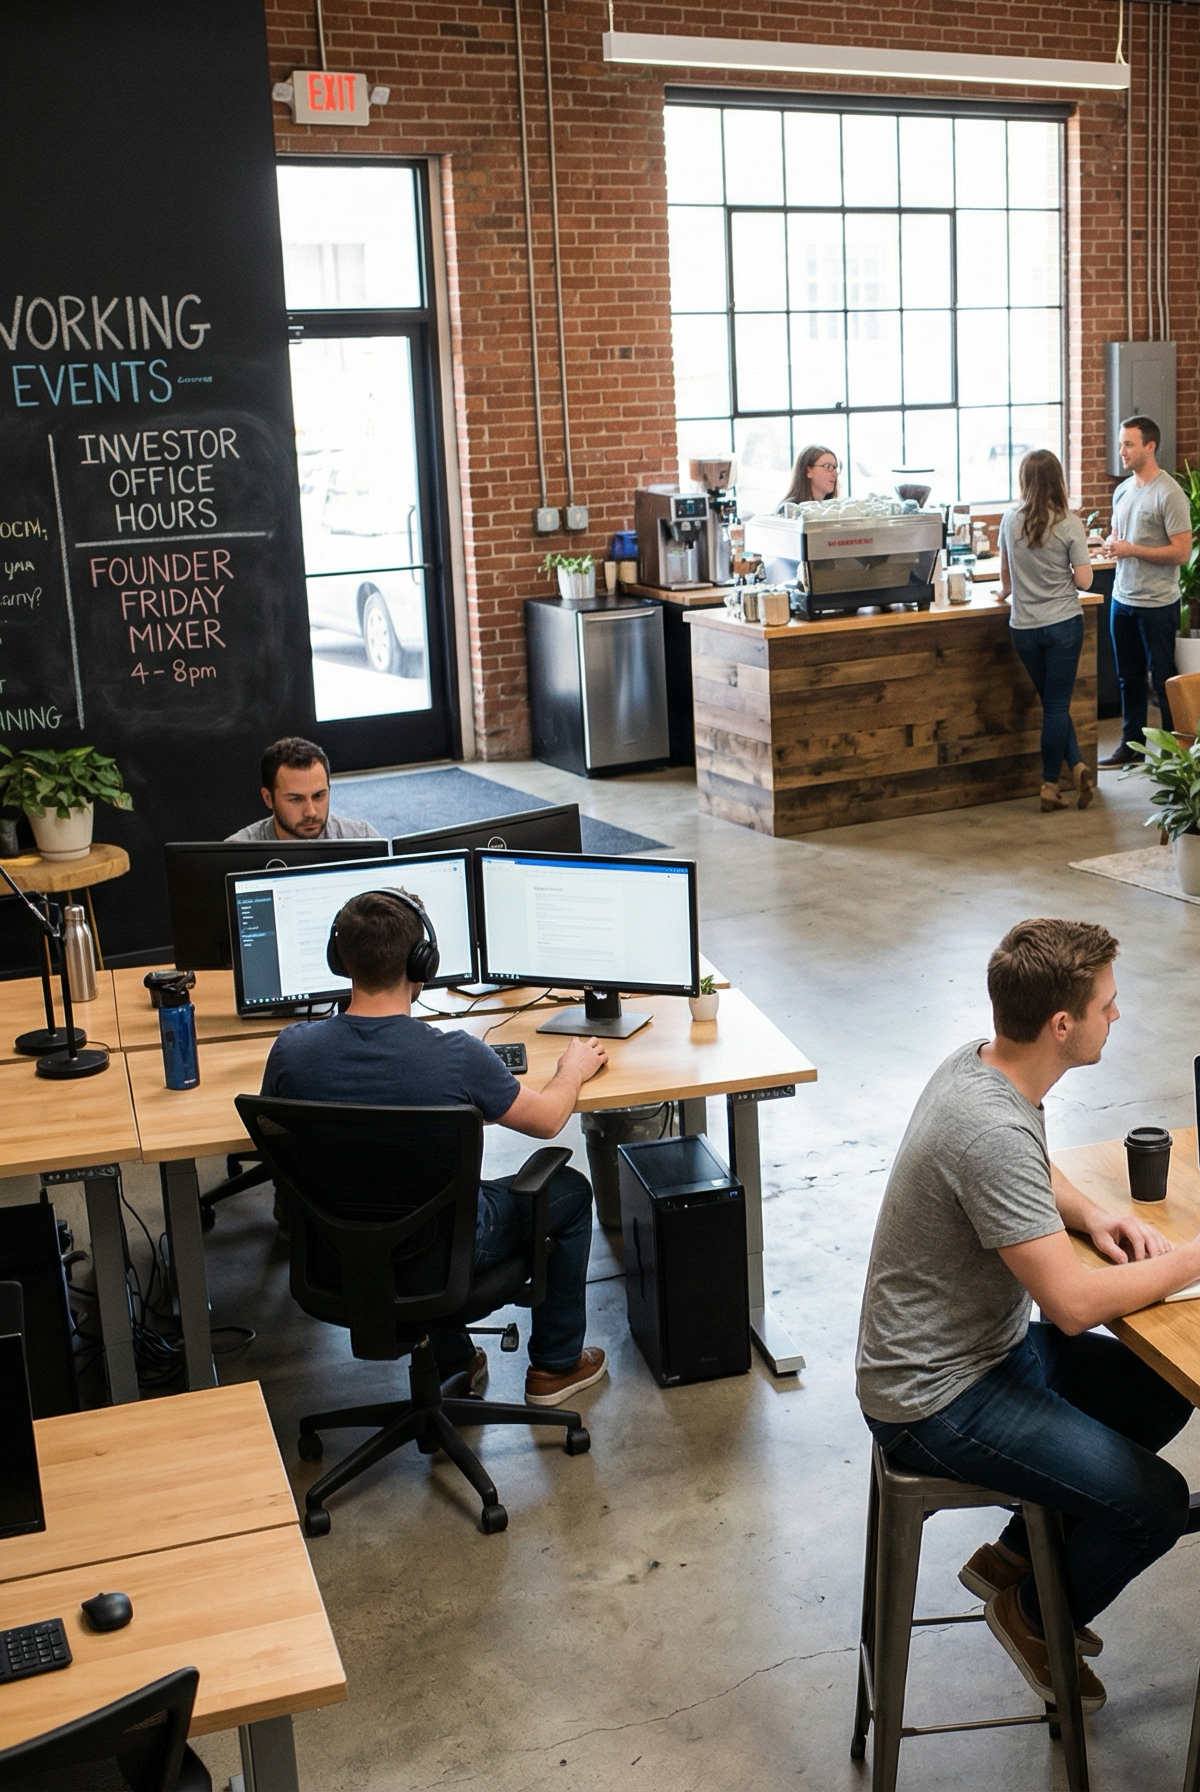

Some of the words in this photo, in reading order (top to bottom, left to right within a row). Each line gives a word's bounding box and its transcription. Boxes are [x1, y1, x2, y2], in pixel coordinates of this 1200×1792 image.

[307, 73, 356, 112] EXIT
[12, 358, 173, 407] EVENTS
[78, 427, 240, 464] INVESTOR
[109, 464, 215, 498] OFFICE
[115, 498, 218, 533] HOURS
[90, 549, 234, 588] FOUNDER
[121, 585, 225, 620] FRIDAY
[129, 619, 227, 653] MIXER
